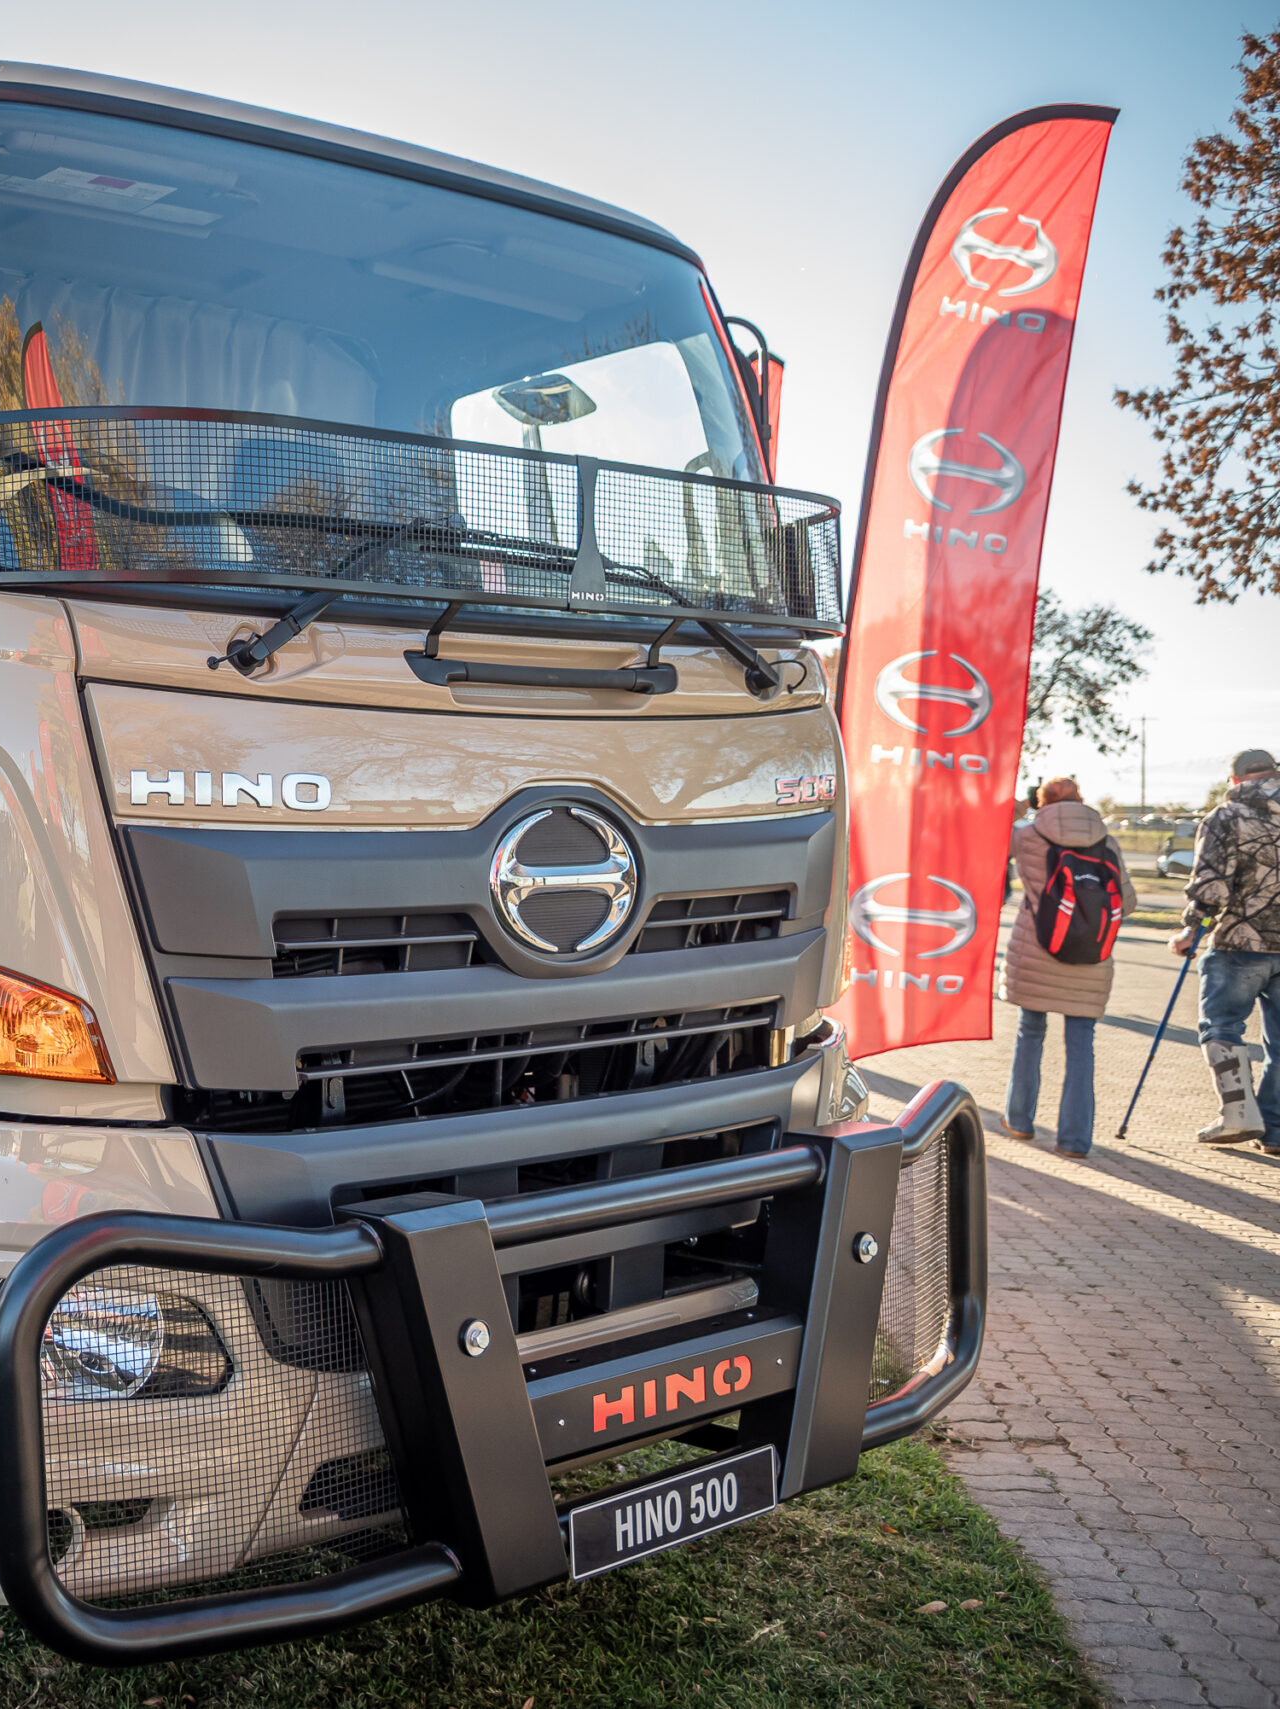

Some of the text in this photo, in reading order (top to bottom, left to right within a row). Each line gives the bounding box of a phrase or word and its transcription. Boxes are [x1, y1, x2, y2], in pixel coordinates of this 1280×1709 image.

[940, 296, 1046, 333] HINO
[904, 519, 1007, 554] HINO
[571, 591, 604, 601] HINO
[871, 744, 990, 774] HINO
[130, 769, 332, 811] HINO
[776, 775, 836, 806] 500
[850, 967, 964, 994] HINO
[593, 1355, 752, 1433] HINO
[615, 1472, 738, 1552] HINO 500
